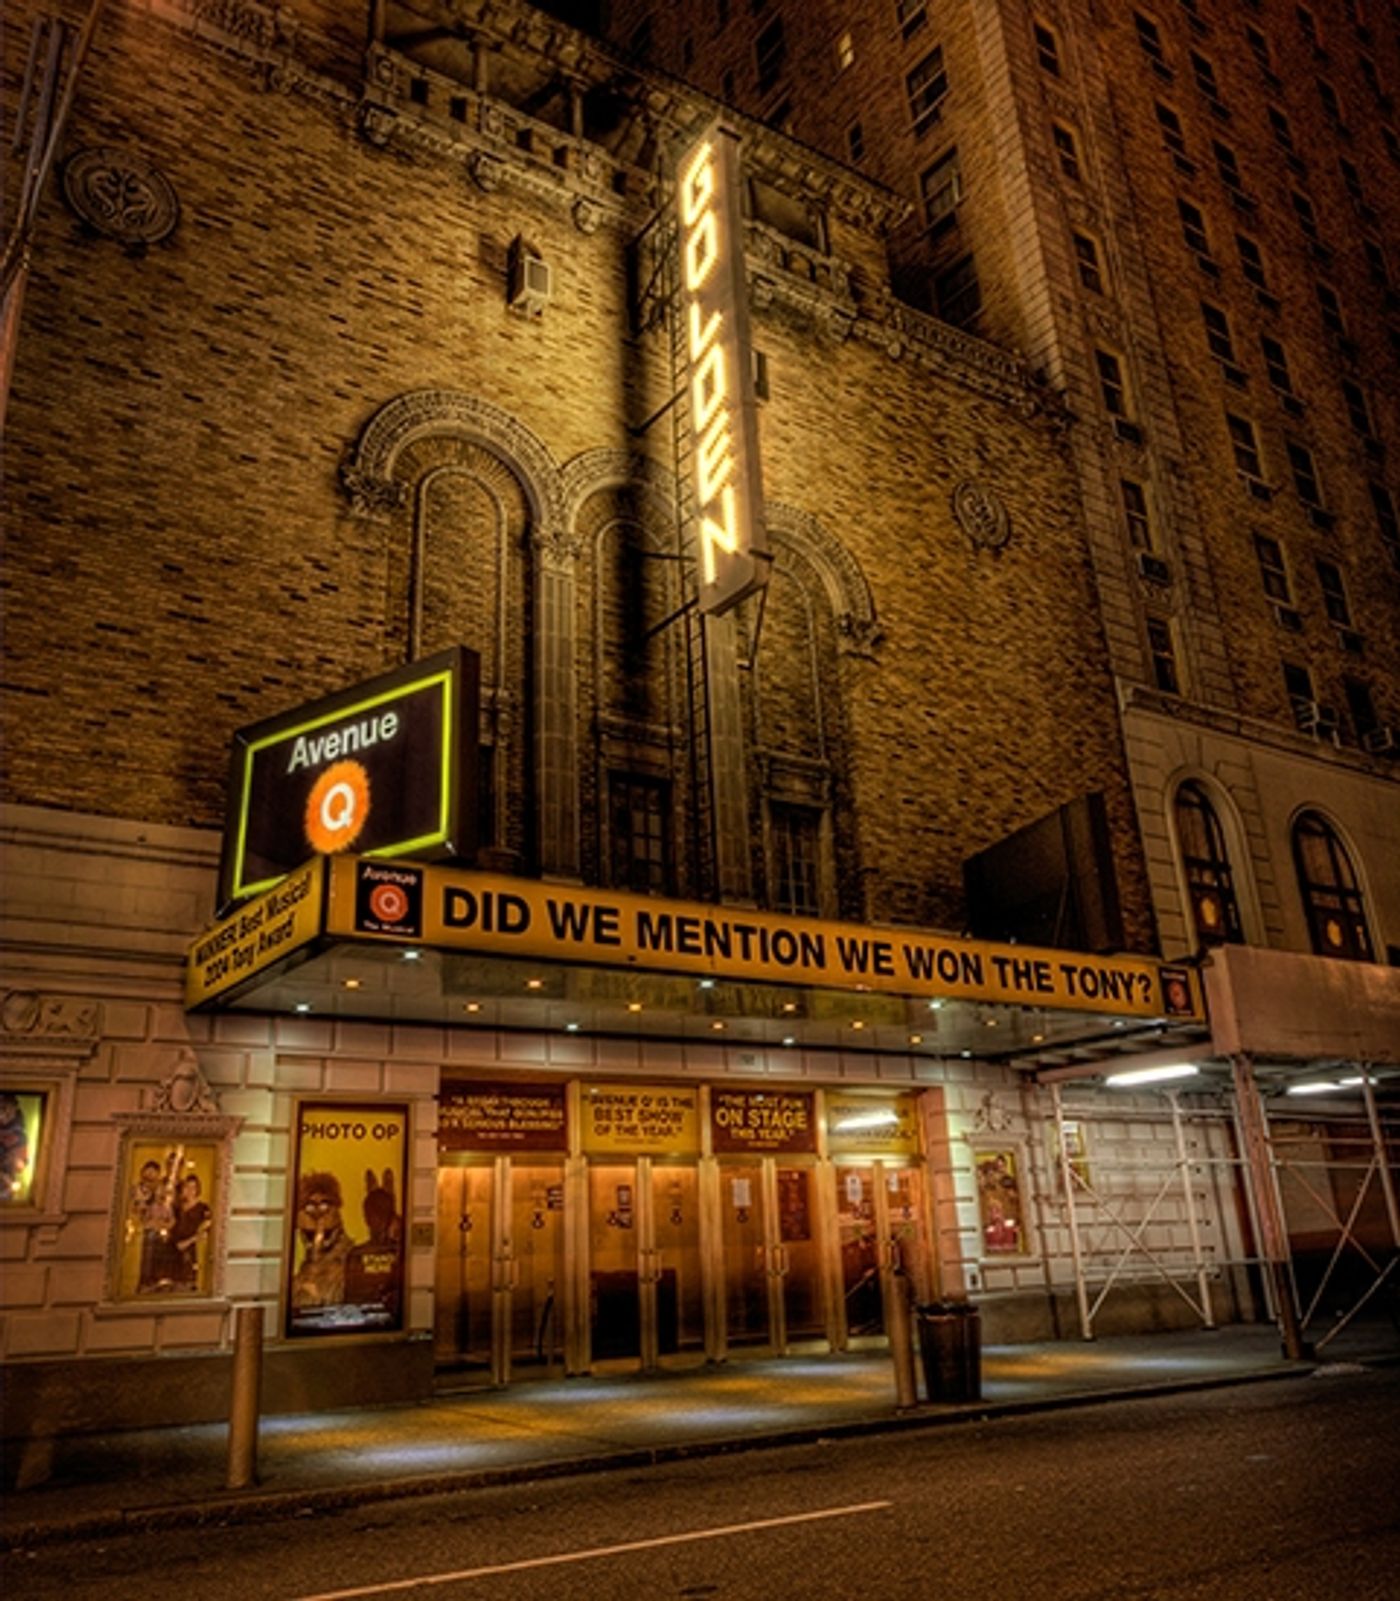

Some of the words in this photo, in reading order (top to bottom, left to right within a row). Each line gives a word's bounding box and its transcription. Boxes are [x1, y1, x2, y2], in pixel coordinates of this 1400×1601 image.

[682, 142, 740, 586] GOLDEN
[287, 711, 399, 774] Avenue
[320, 781, 356, 832] Q
[443, 885, 531, 935] DID
[546, 899, 621, 946] WE
[637, 911, 826, 969] MENTION
[837, 936, 895, 976] WE
[903, 945, 984, 986] WON
[991, 956, 1055, 993] THE
[1060, 964, 1152, 1005] TONY?
[300, 1122, 367, 1140] PHOTO
[371, 1122, 399, 1140] OP
[593, 1123, 612, 1137] OF
[614, 1123, 638, 1137] THE
[594, 1107, 634, 1122] BEST
[638, 1109, 684, 1124] SHOW
[716, 1107, 744, 1128] ON
[747, 1108, 807, 1131] STAGE
